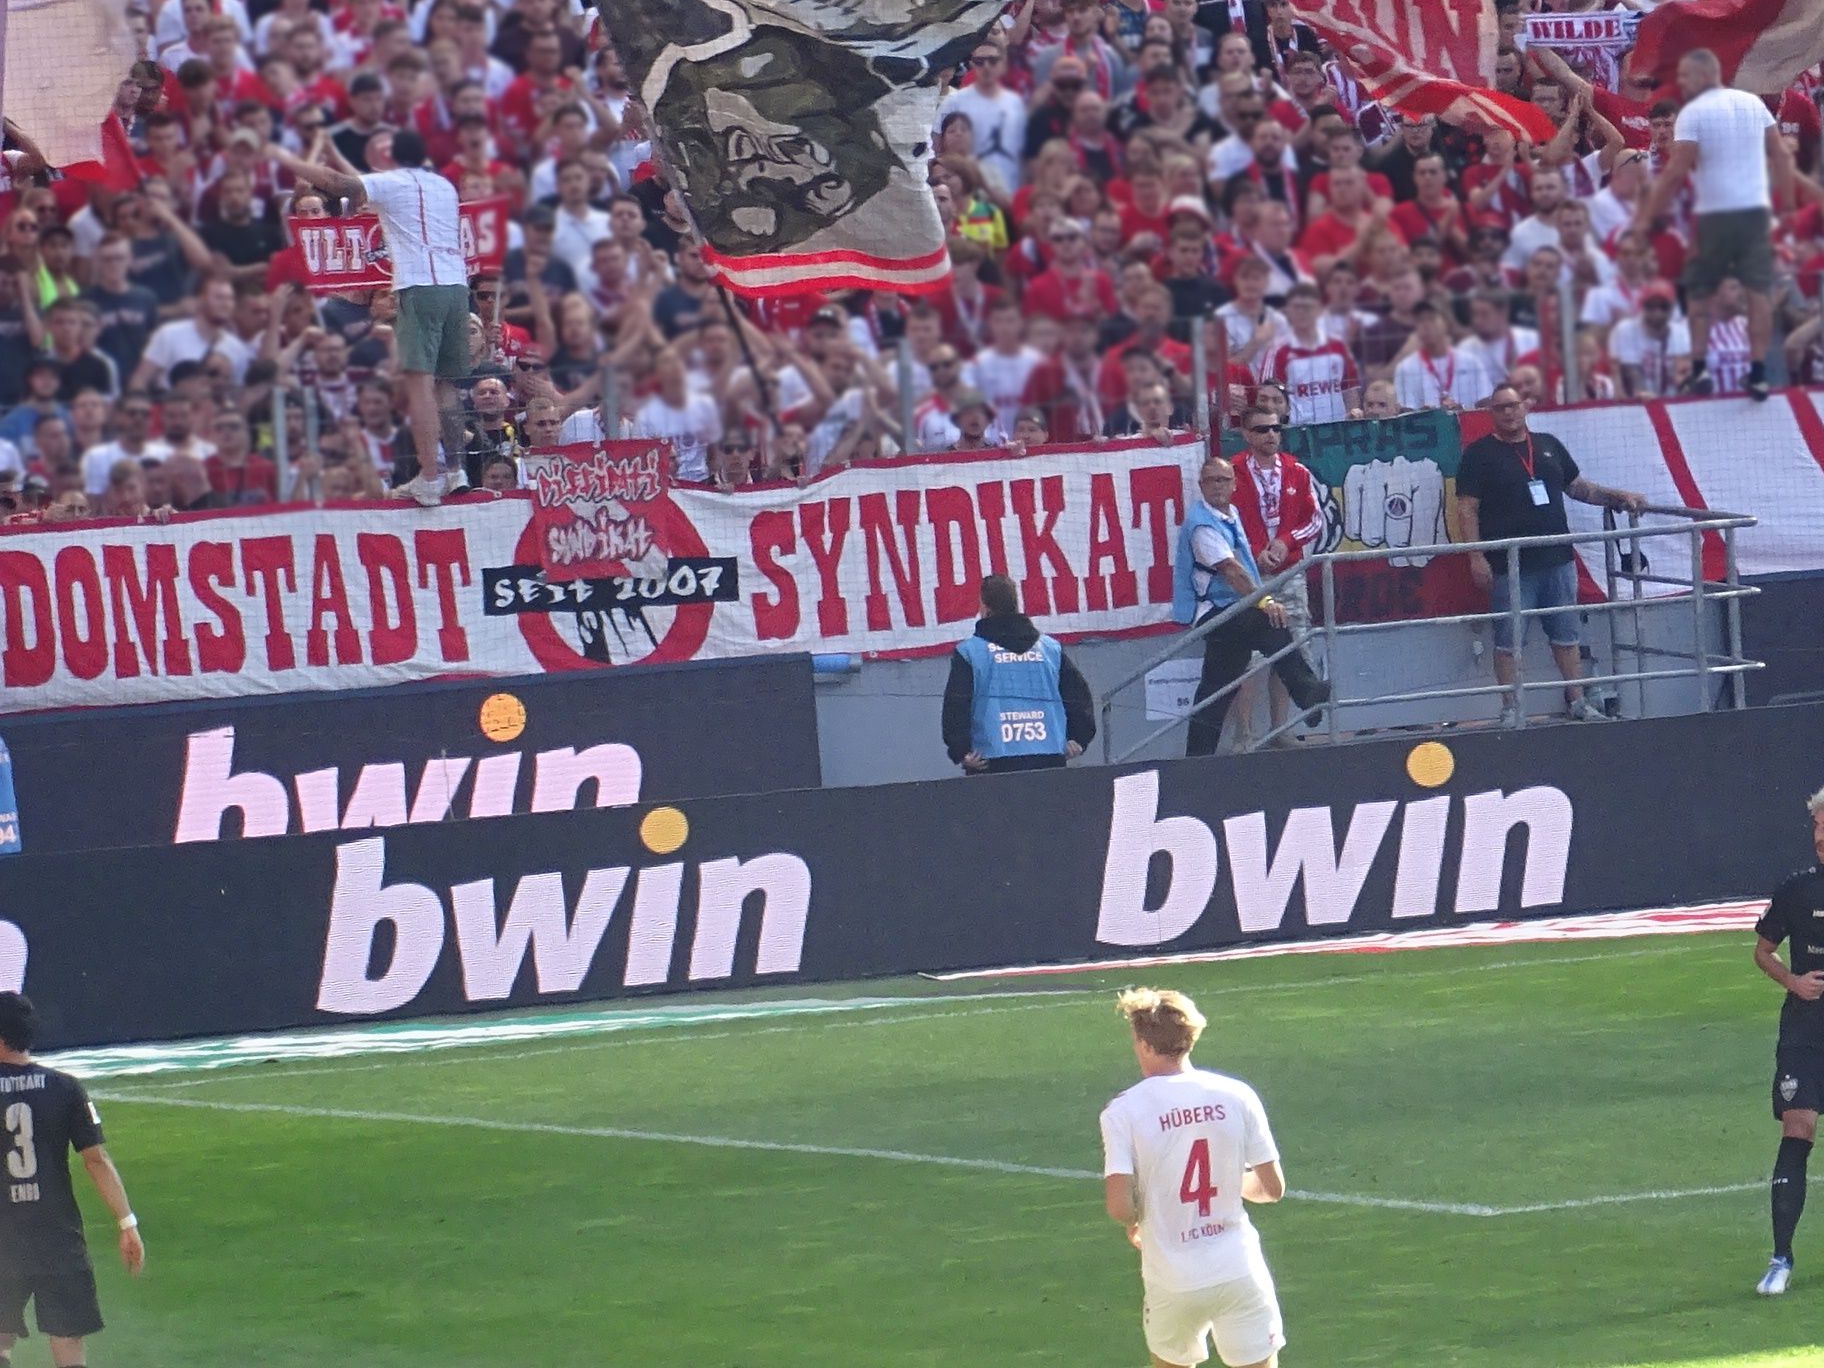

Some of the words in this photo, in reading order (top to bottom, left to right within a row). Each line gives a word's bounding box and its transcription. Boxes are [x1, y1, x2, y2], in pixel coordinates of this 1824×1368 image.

[1296, 380, 1343, 399] REWE
[751, 464, 1185, 640] SYNDIKAT
[2, 528, 472, 687] DOMSTADT
[999, 710, 1045, 721] STEWARD
[1001, 722, 1047, 743] 0753
[1095, 741, 1574, 946] bwin
[315, 806, 813, 1015] bwin
[5, 1101, 38, 1179] 3
[1159, 1104, 1227, 1132] HÜBERS
[1180, 1138, 1218, 1217] 4
